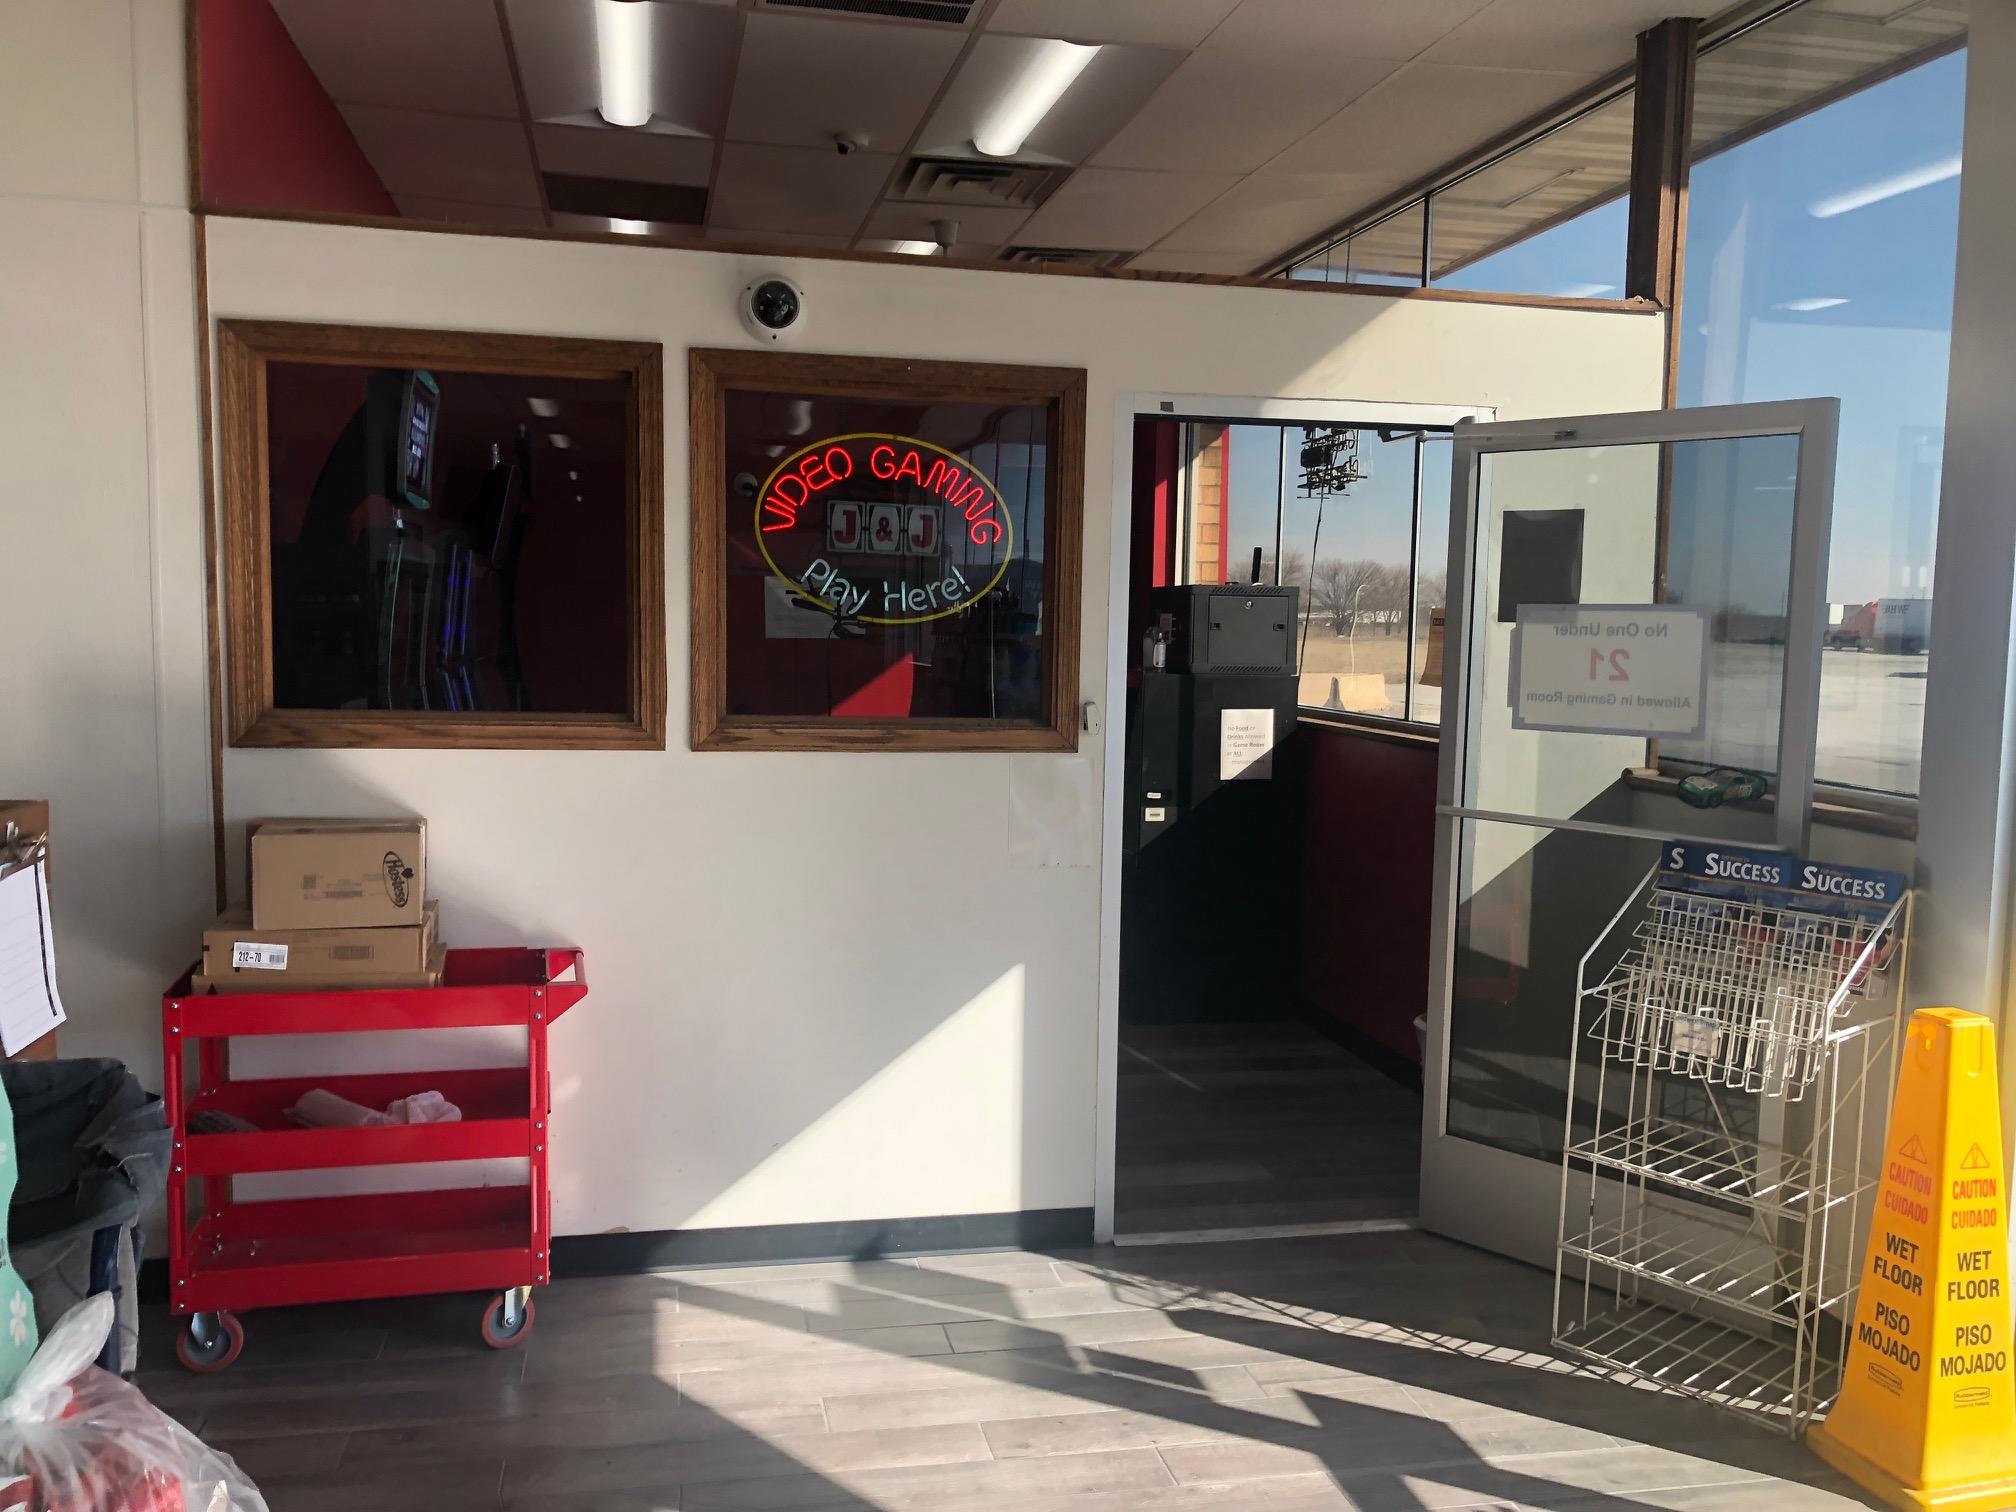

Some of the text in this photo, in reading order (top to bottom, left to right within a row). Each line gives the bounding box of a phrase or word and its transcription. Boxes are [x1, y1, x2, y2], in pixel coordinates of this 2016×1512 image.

[763, 444, 1002, 545] VIDEO GAMING
[800, 558, 972, 614] Play Here!
[1704, 853, 1780, 885] SUCCESS
[1801, 866, 1886, 900] SUCCESS
[1888, 1161, 1932, 1196] CAUTION
[1952, 1178, 1997, 1201] CAUTION
[1884, 1190, 1929, 1226] CUIDADO
[1951, 1208, 1997, 1230] CUIDADO
[1886, 1231, 1920, 1264] WET
[1957, 1250, 1992, 1273] WET
[1873, 1255, 1923, 1297] FLOOR
[1947, 1277, 2000, 1302] FLOOR
[1875, 1301, 1910, 1337] PISO
[1955, 1323, 1992, 1348] PISO
[1858, 1321, 1921, 1374] MOJADO
[1940, 1351, 2007, 1379] MOJADO
